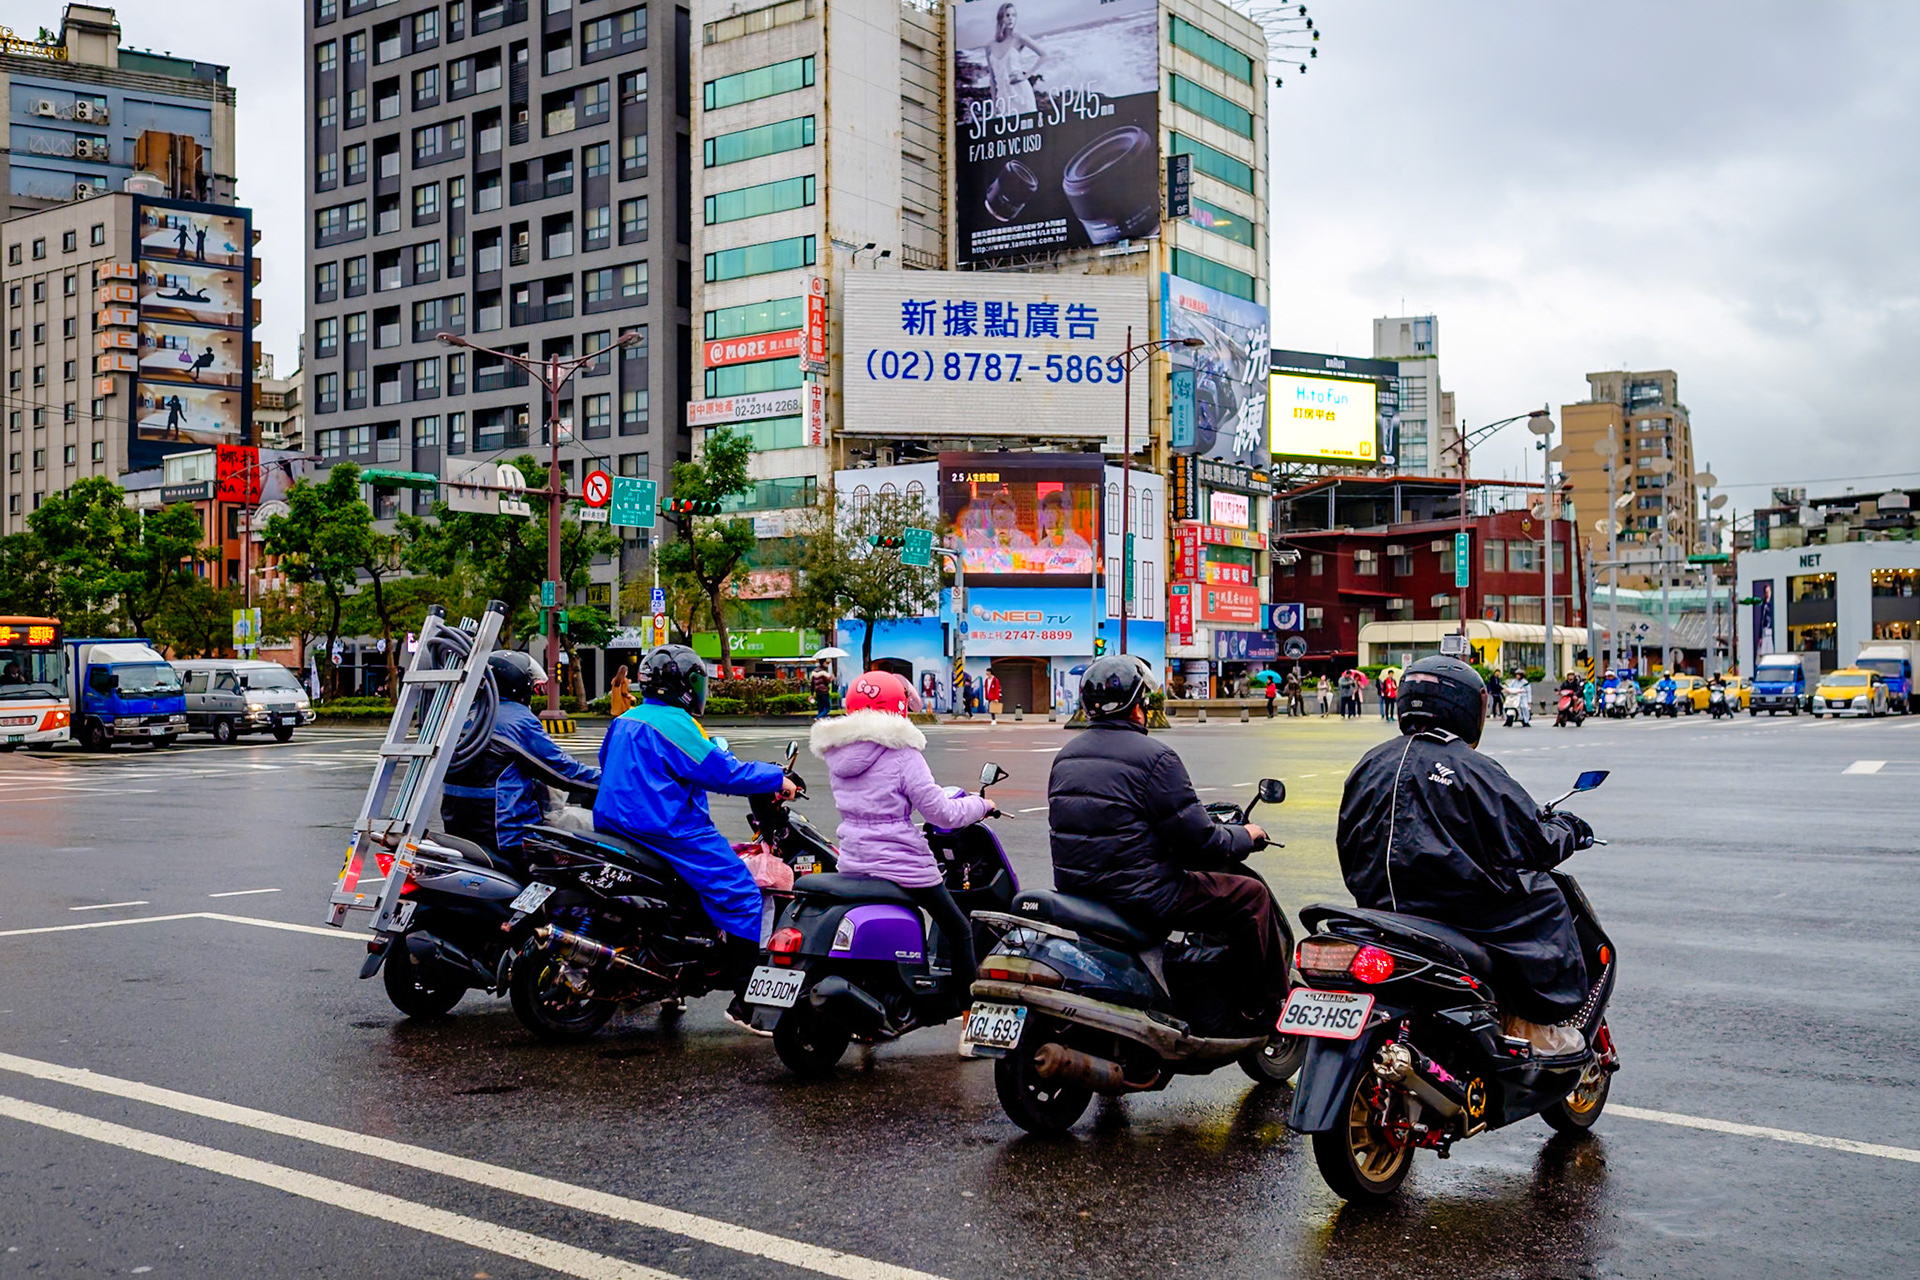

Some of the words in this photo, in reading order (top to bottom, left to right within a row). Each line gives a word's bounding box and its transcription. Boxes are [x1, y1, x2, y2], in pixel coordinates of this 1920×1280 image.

[969, 141, 995, 162] F/1.8
[997, 138, 1006, 157] Di
[1008, 137, 1021, 156] VC
[1023, 133, 1042, 153] USD
[116, 263, 133, 370] HOTEL
[901, 299, 1099, 340] 新據點廣告
[1233, 324, 1268, 457] 洗練
[735, 402, 772, 417] 02-2314
[775, 399, 799, 413] 2268
[1293, 407, 1335, 421] 訂房平台
[1800, 554, 1821, 567] NET
[992, 611, 1043, 622] NEO
[1046, 615, 1072, 624] TV
[1005, 630, 1072, 640] 2747-8899
[1428, 773, 1453, 786] JUMP
[1022, 901, 1039, 911] SYM
